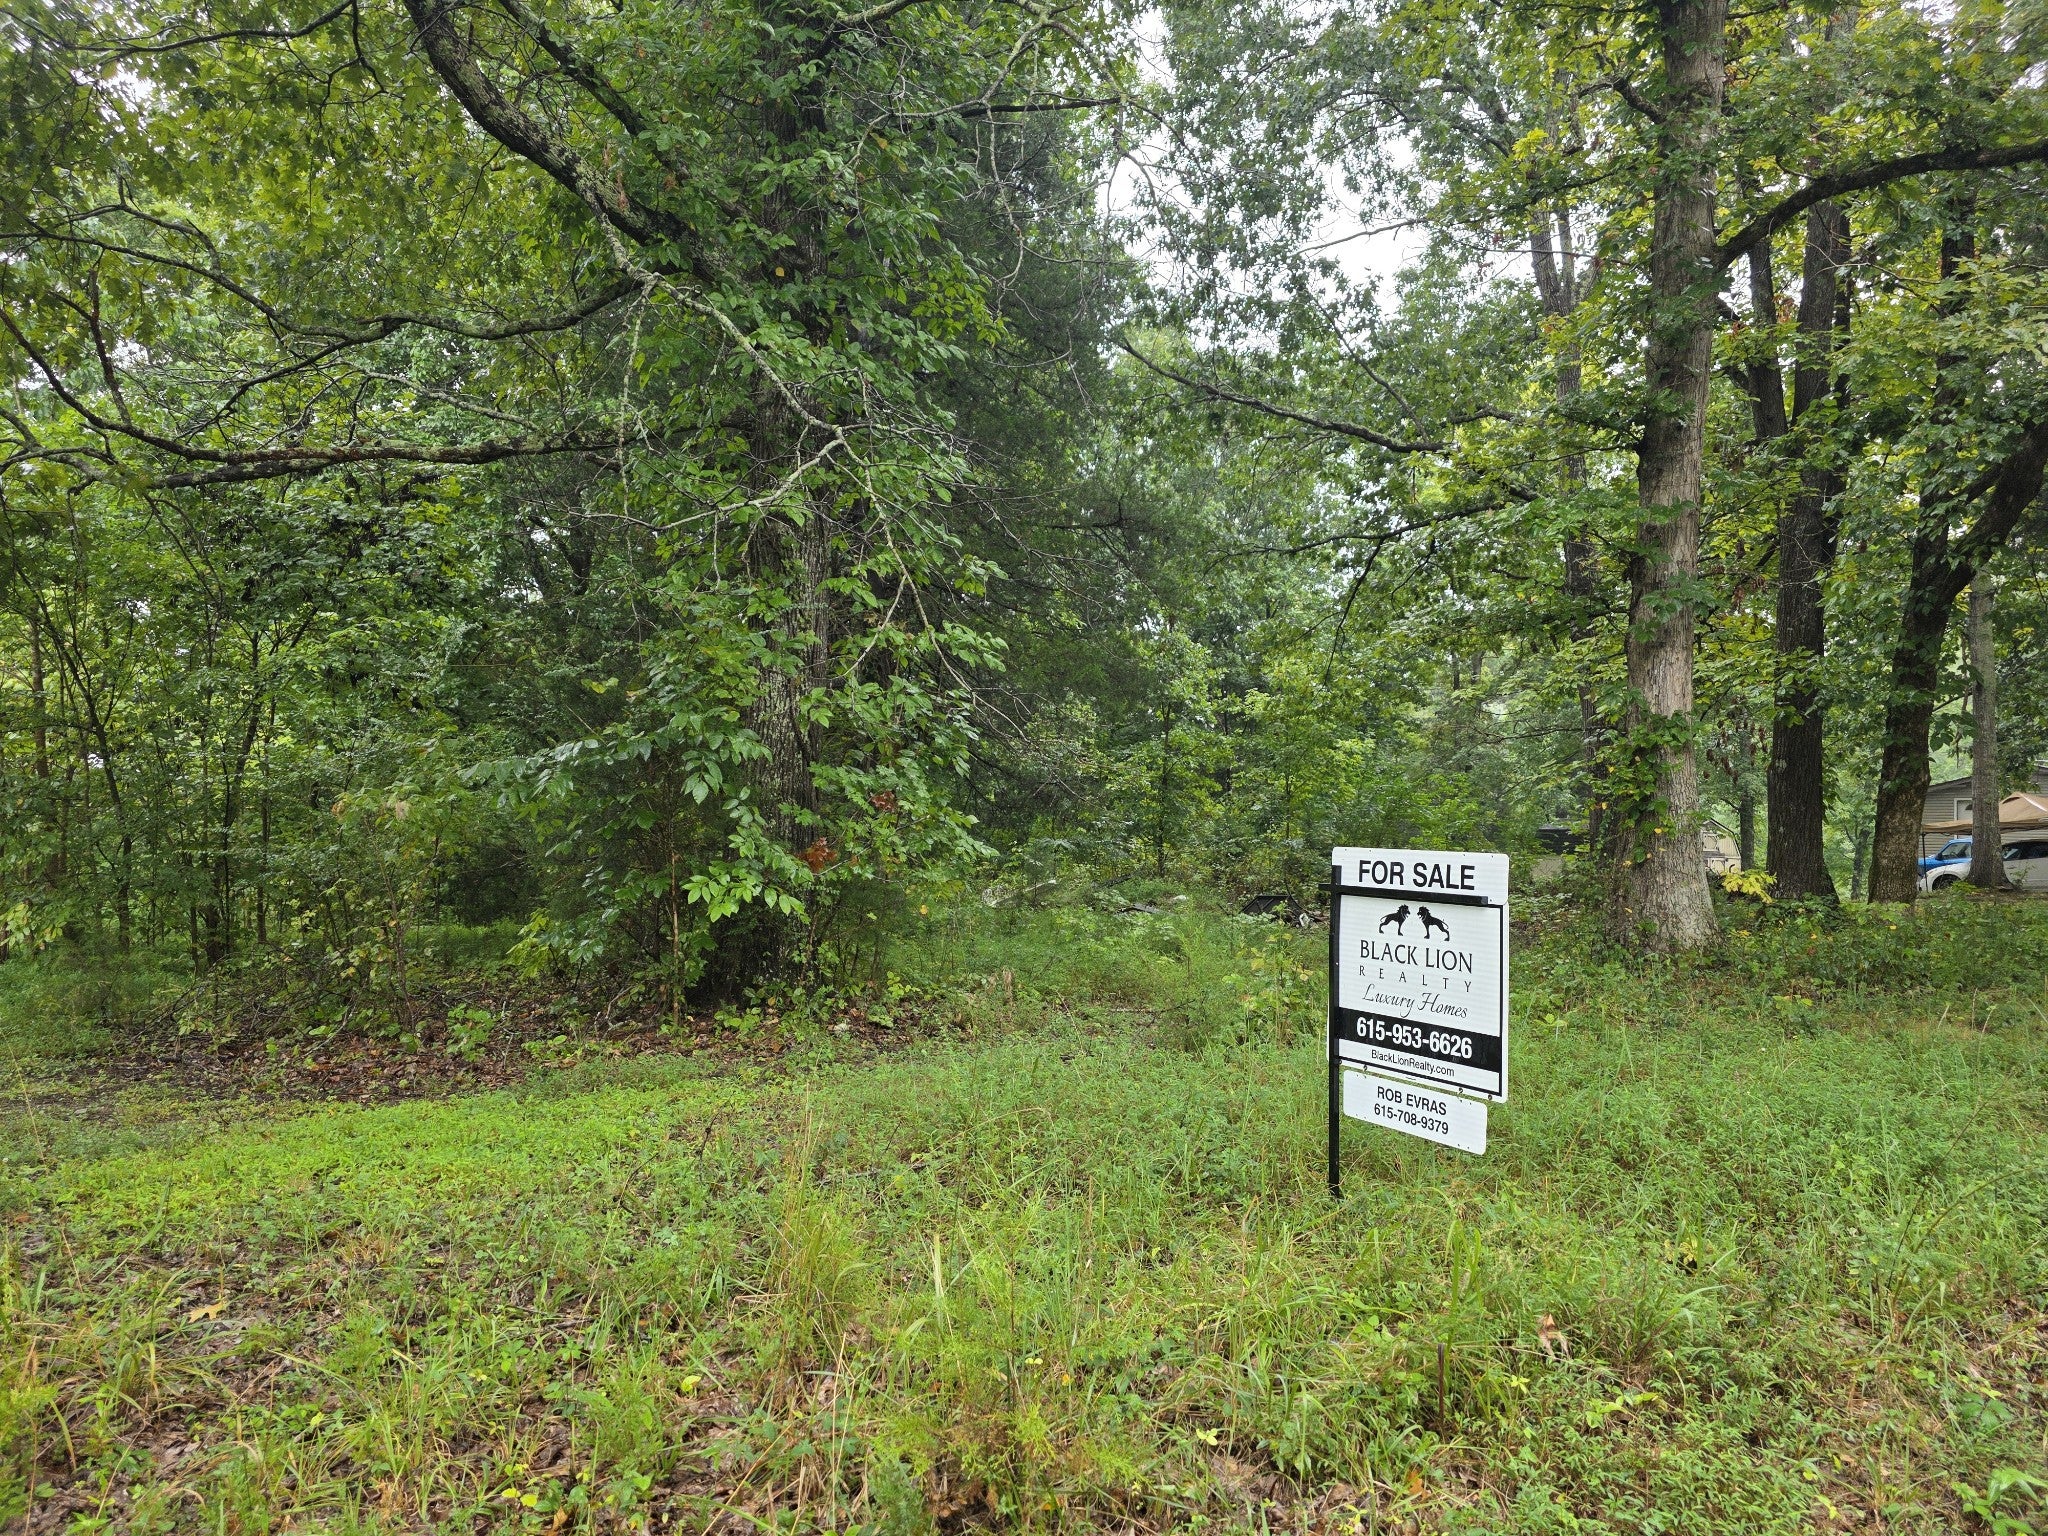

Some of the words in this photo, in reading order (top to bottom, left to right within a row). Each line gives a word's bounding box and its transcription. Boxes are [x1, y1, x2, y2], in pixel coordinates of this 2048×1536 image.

[1359, 860, 1404, 885] FOR
[1413, 862, 1475, 890] SALE
[1360, 940, 1418, 966] BLACK
[1425, 947, 1472, 974] LION
[1362, 983, 1415, 1018] Luxury
[1417, 992, 1468, 1018] Homes
[1357, 1017, 1472, 1059] 615-953-6626
[1371, 1050, 1455, 1077] BlackLionRealty.com
[1377, 1086, 1402, 1103] ROB
[1406, 1094, 1447, 1115] EVRAS
[1374, 1103, 1449, 1135] 615-708-9379
